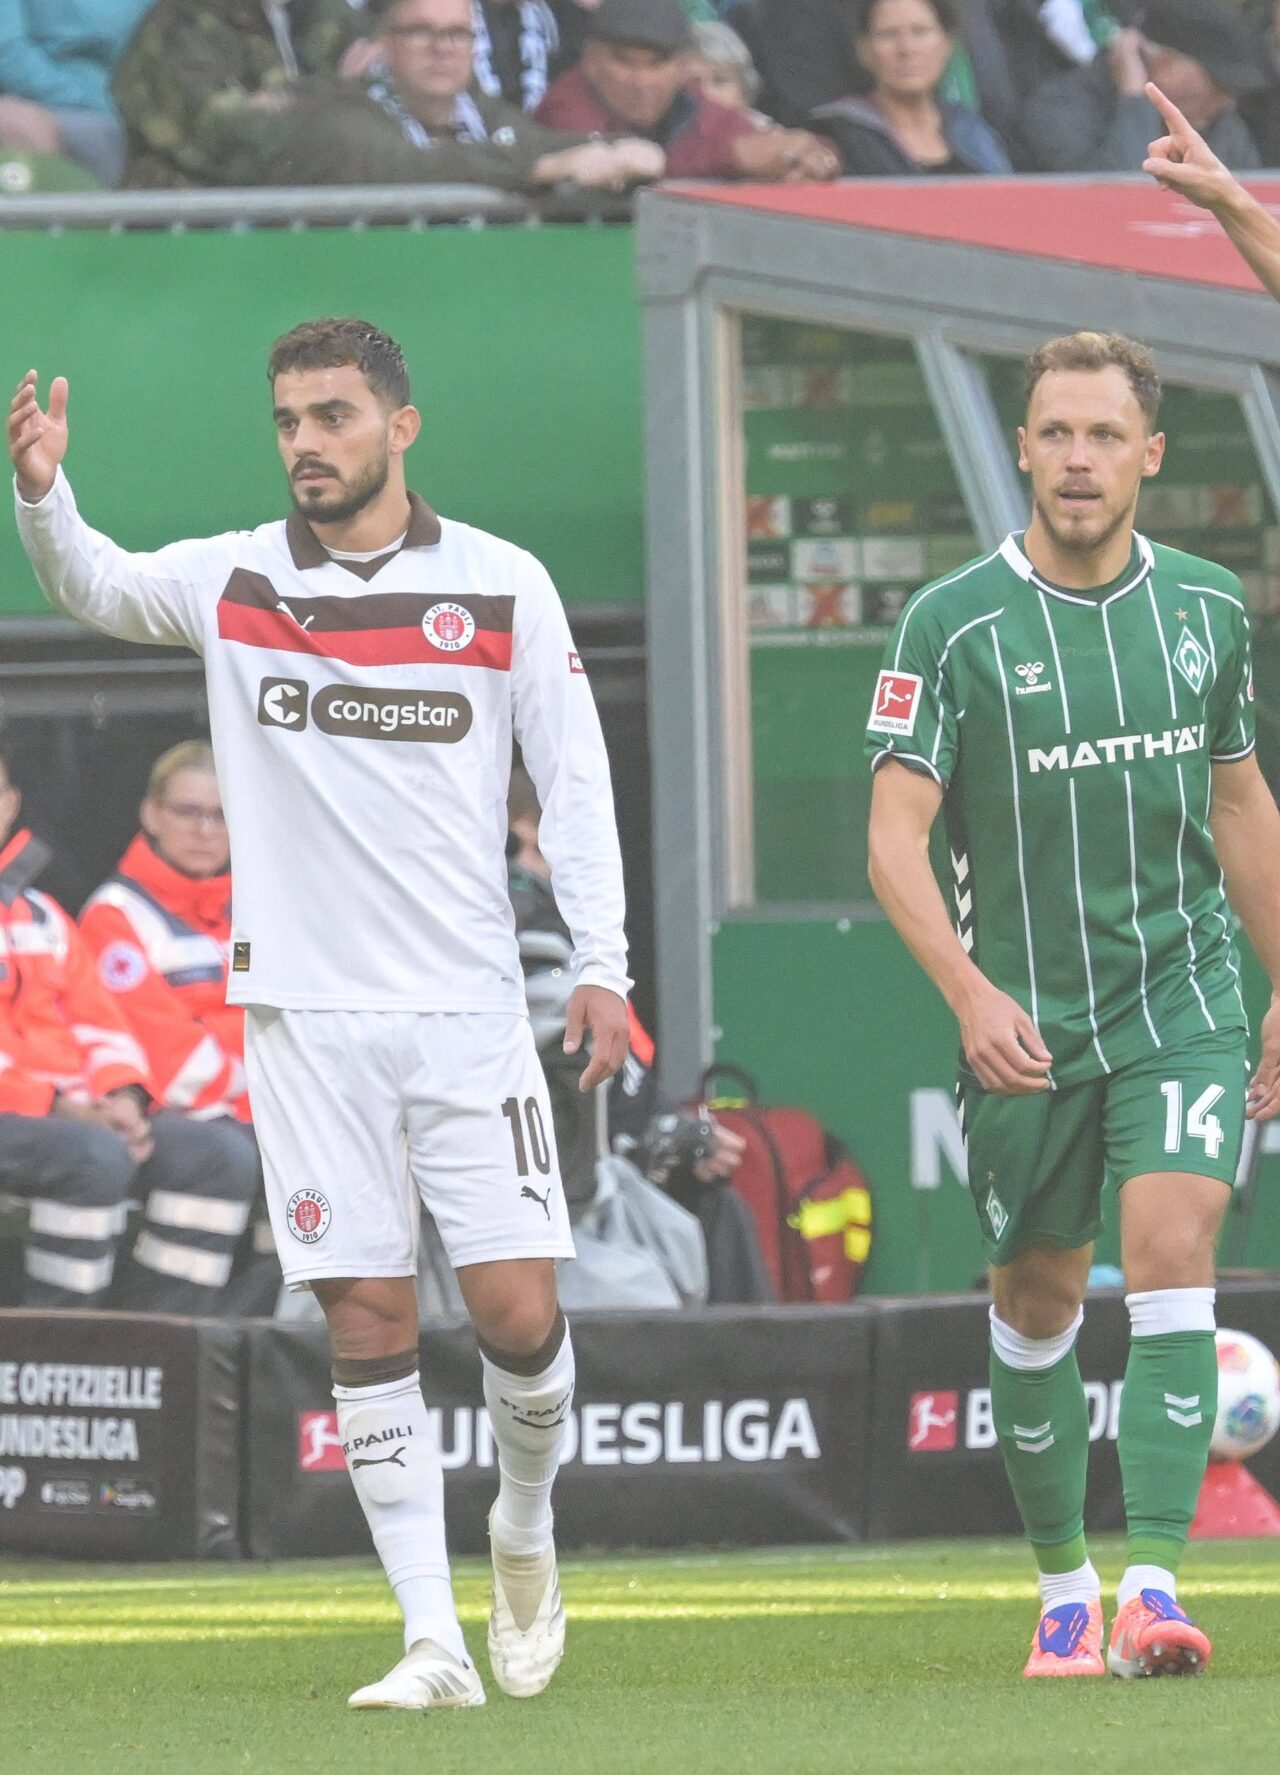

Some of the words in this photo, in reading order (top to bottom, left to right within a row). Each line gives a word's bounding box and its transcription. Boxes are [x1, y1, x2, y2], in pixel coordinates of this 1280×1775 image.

[449, 605, 473, 626] PAULI
[439, 641, 460, 649] 1910
[328, 700, 459, 731] congstar
[1161, 1081, 1224, 1158] 14
[501, 1096, 550, 1176] 10
[305, 1192, 328, 1212] PAULI
[303, 1232, 318, 1241] 1910
[19, 1362, 163, 1409] OFFIZIELLE
[0, 1414, 139, 1461] UNDESLIGA
